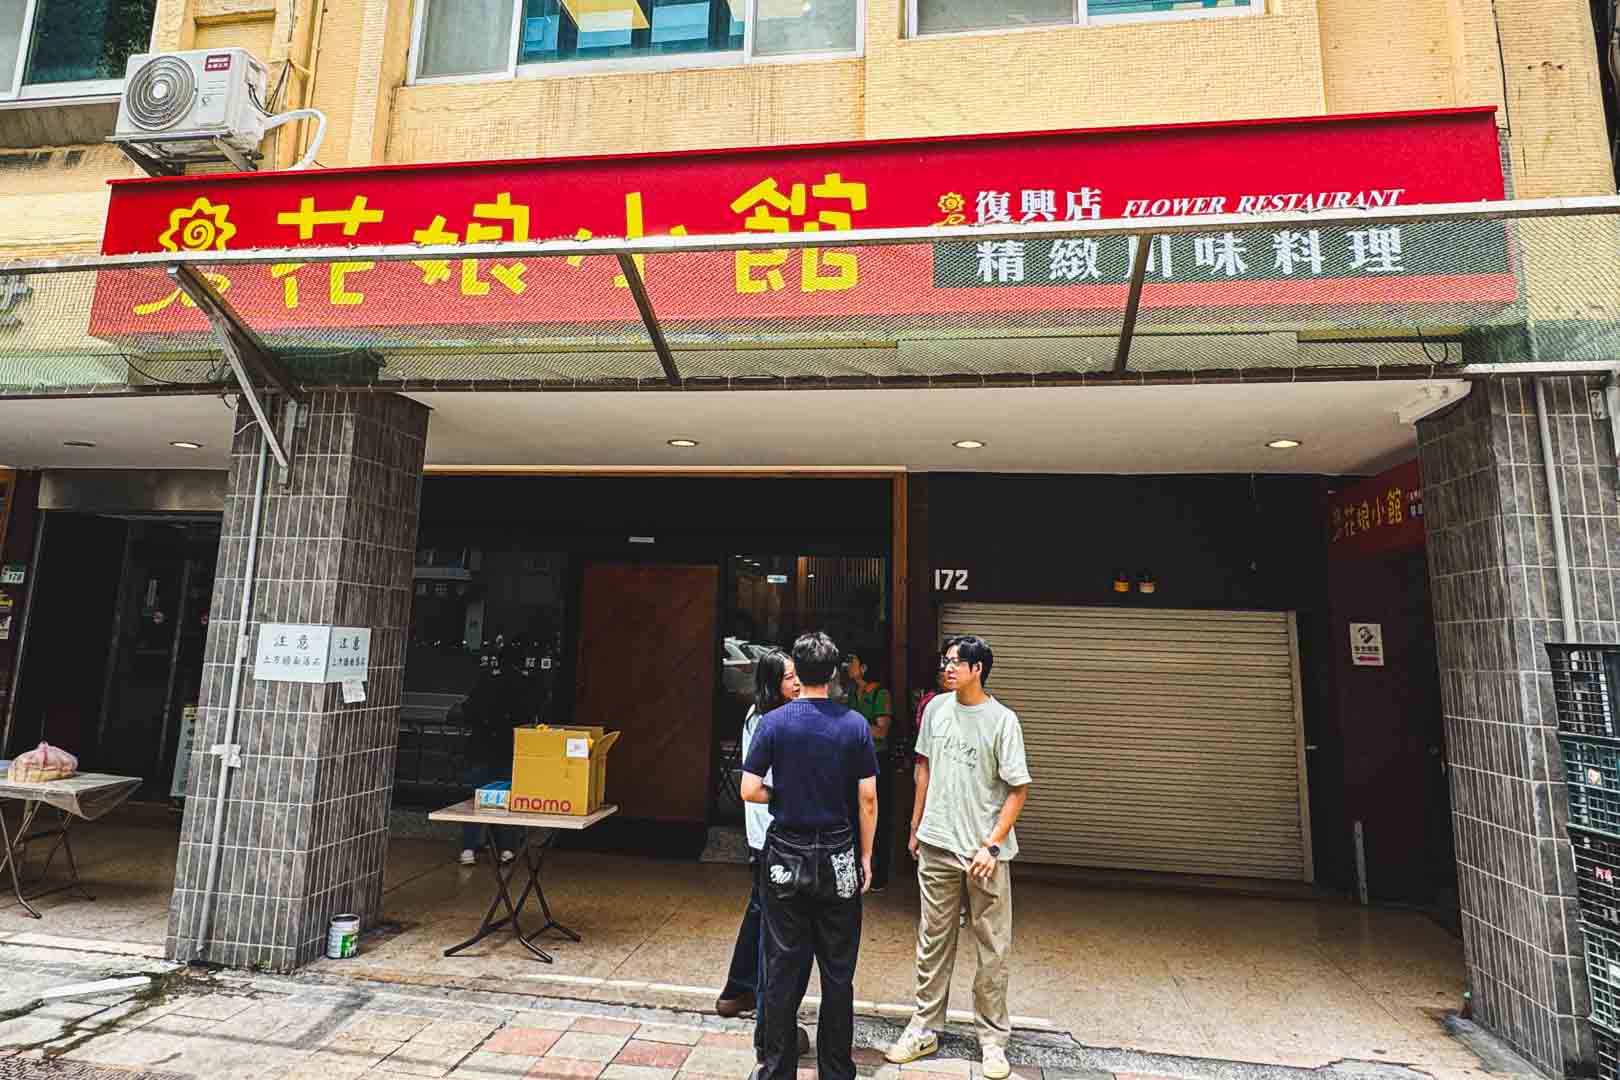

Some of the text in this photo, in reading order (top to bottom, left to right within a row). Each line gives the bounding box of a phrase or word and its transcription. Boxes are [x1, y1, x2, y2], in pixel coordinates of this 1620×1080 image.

[975, 187, 1103, 224] 復興店
[1122, 188, 1406, 218] FLOWER RESTAURANT
[975, 229, 1404, 281] 精緻川味料理
[935, 569, 969, 591] 172
[273, 634, 310, 650] 注意
[513, 796, 572, 812] momo
